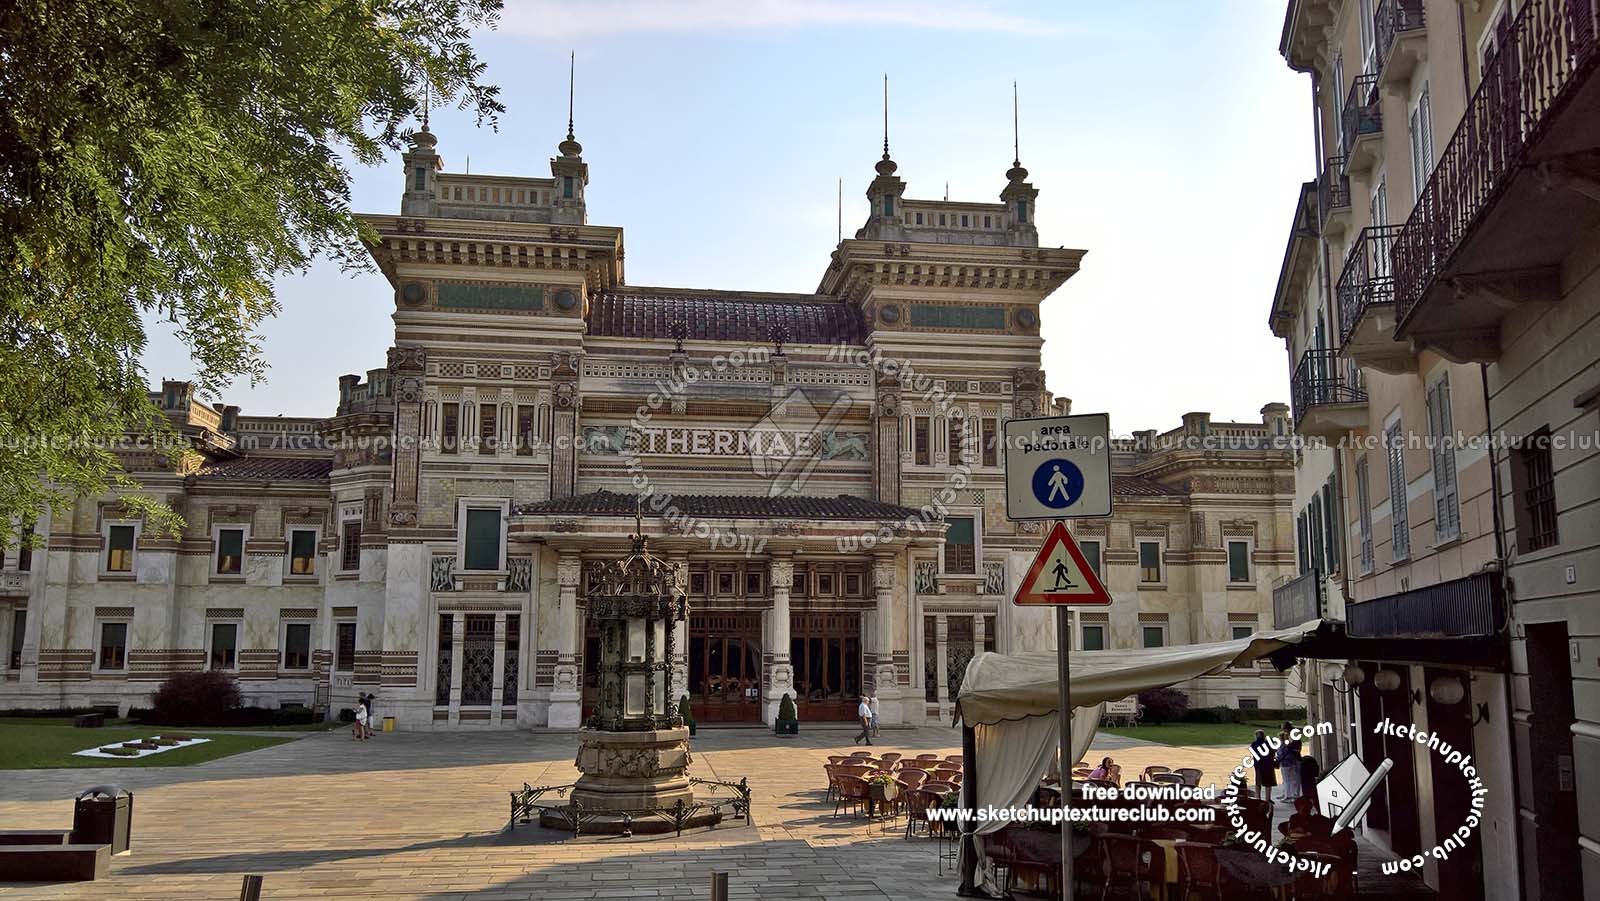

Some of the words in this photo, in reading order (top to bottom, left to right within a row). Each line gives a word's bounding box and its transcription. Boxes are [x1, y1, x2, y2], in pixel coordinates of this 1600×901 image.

[1040, 425, 1071, 435] area
[643, 429, 814, 456] THERMAE
[1024, 440, 1089, 454] pedonale
